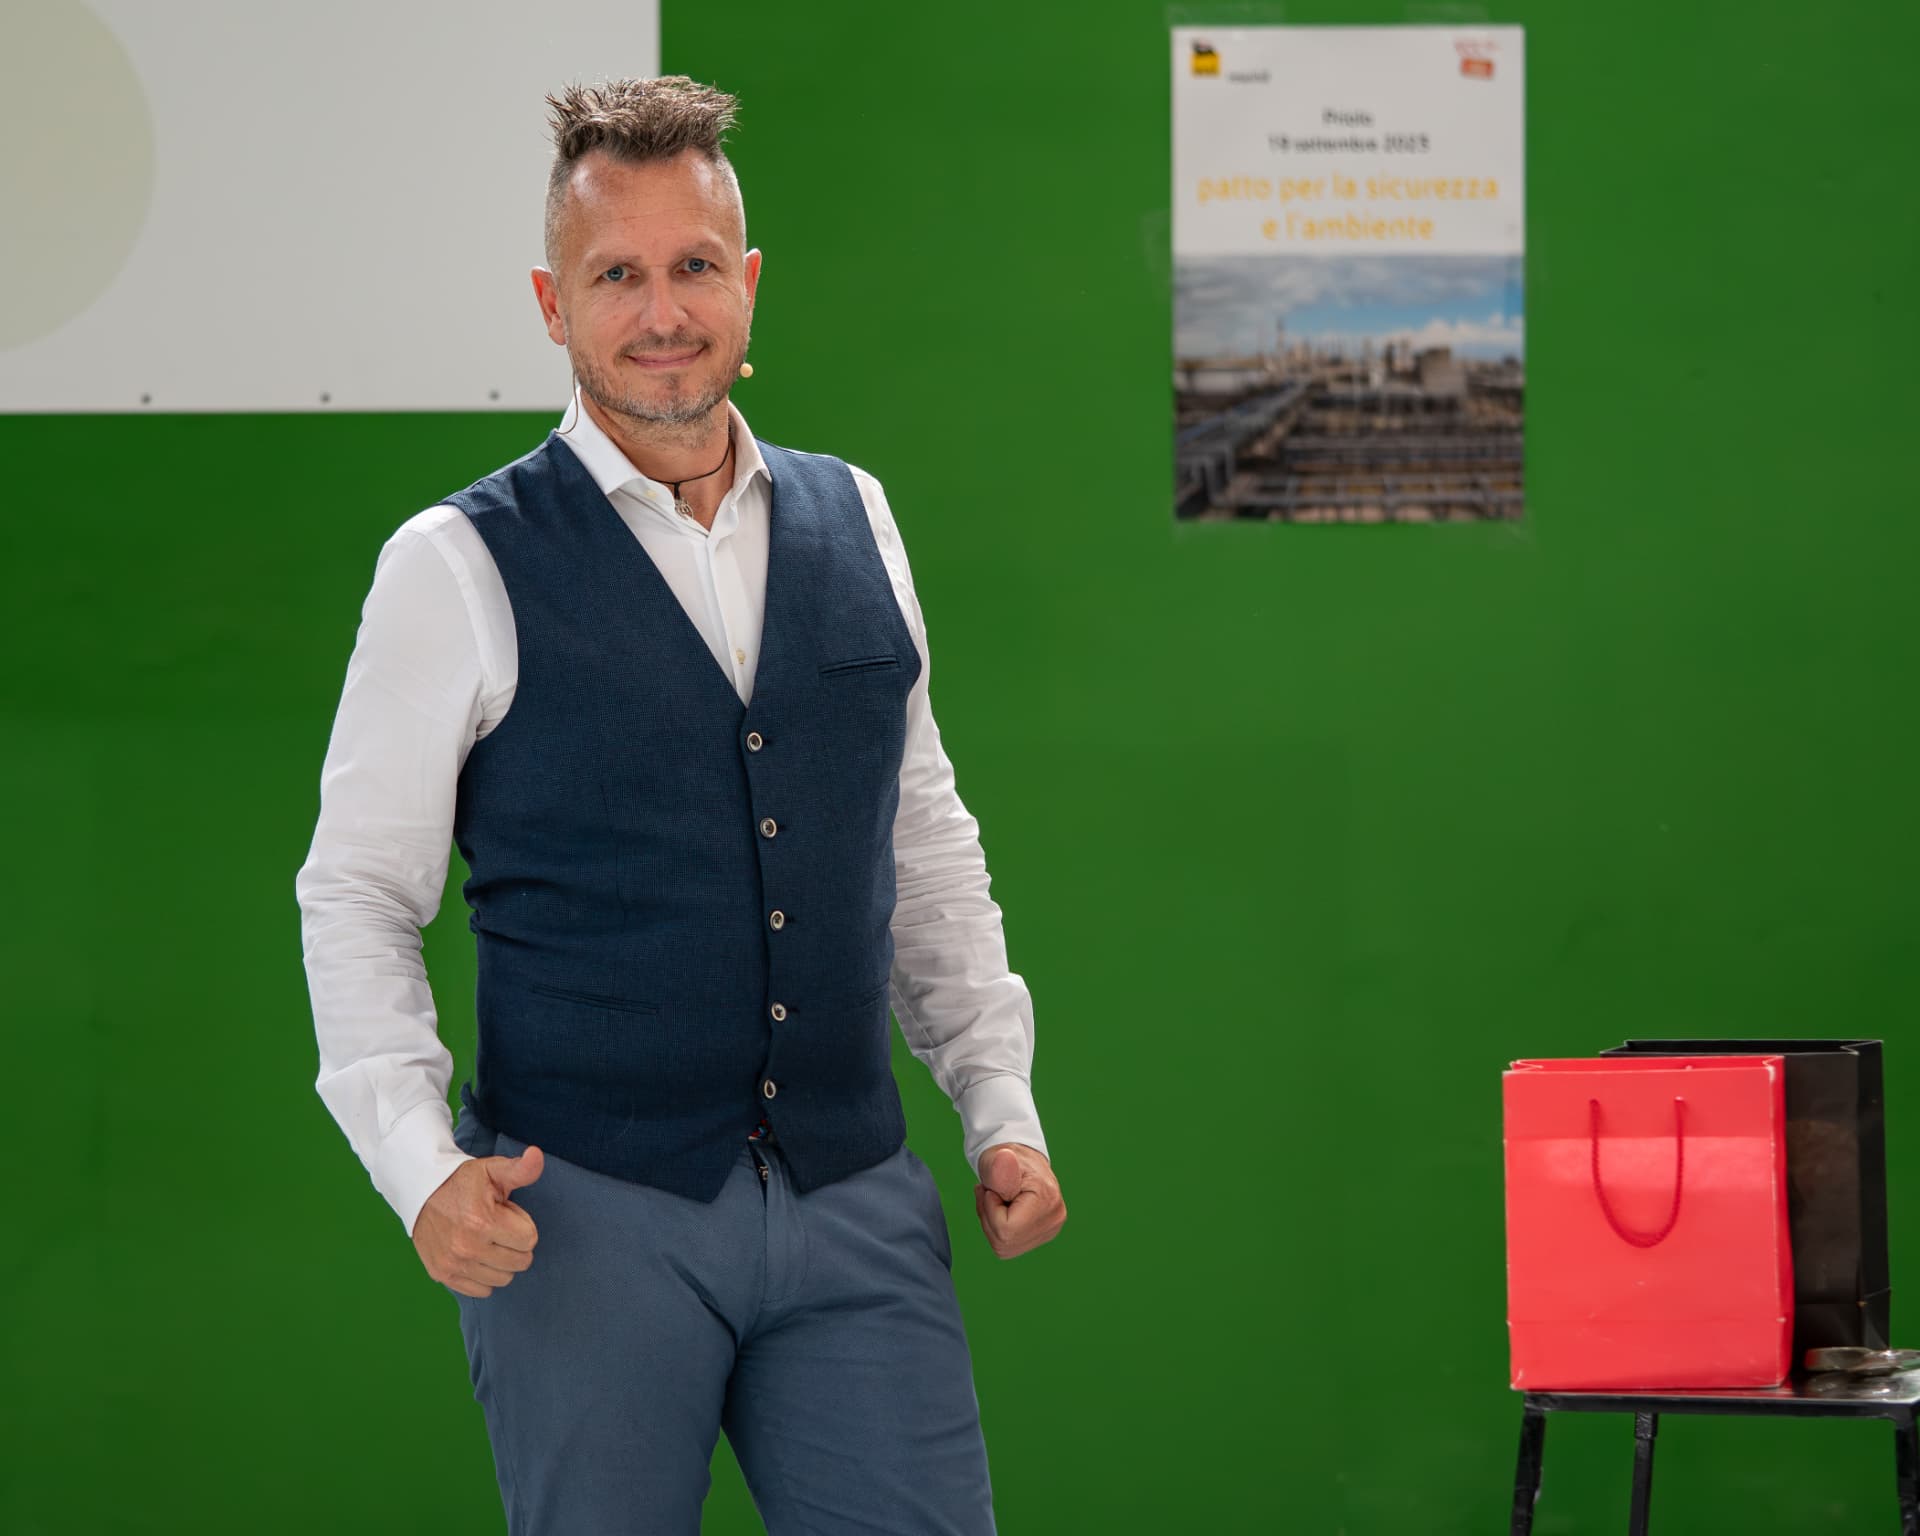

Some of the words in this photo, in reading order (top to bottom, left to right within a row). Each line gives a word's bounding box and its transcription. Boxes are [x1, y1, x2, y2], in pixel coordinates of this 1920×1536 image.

[1198, 177, 1271, 204] patto
[1280, 180, 1323, 204] per
[1333, 173, 1357, 199] la
[1366, 176, 1498, 199] sicurezza
[1261, 219, 1278, 240] e
[1287, 213, 1435, 240] l'ambiente
